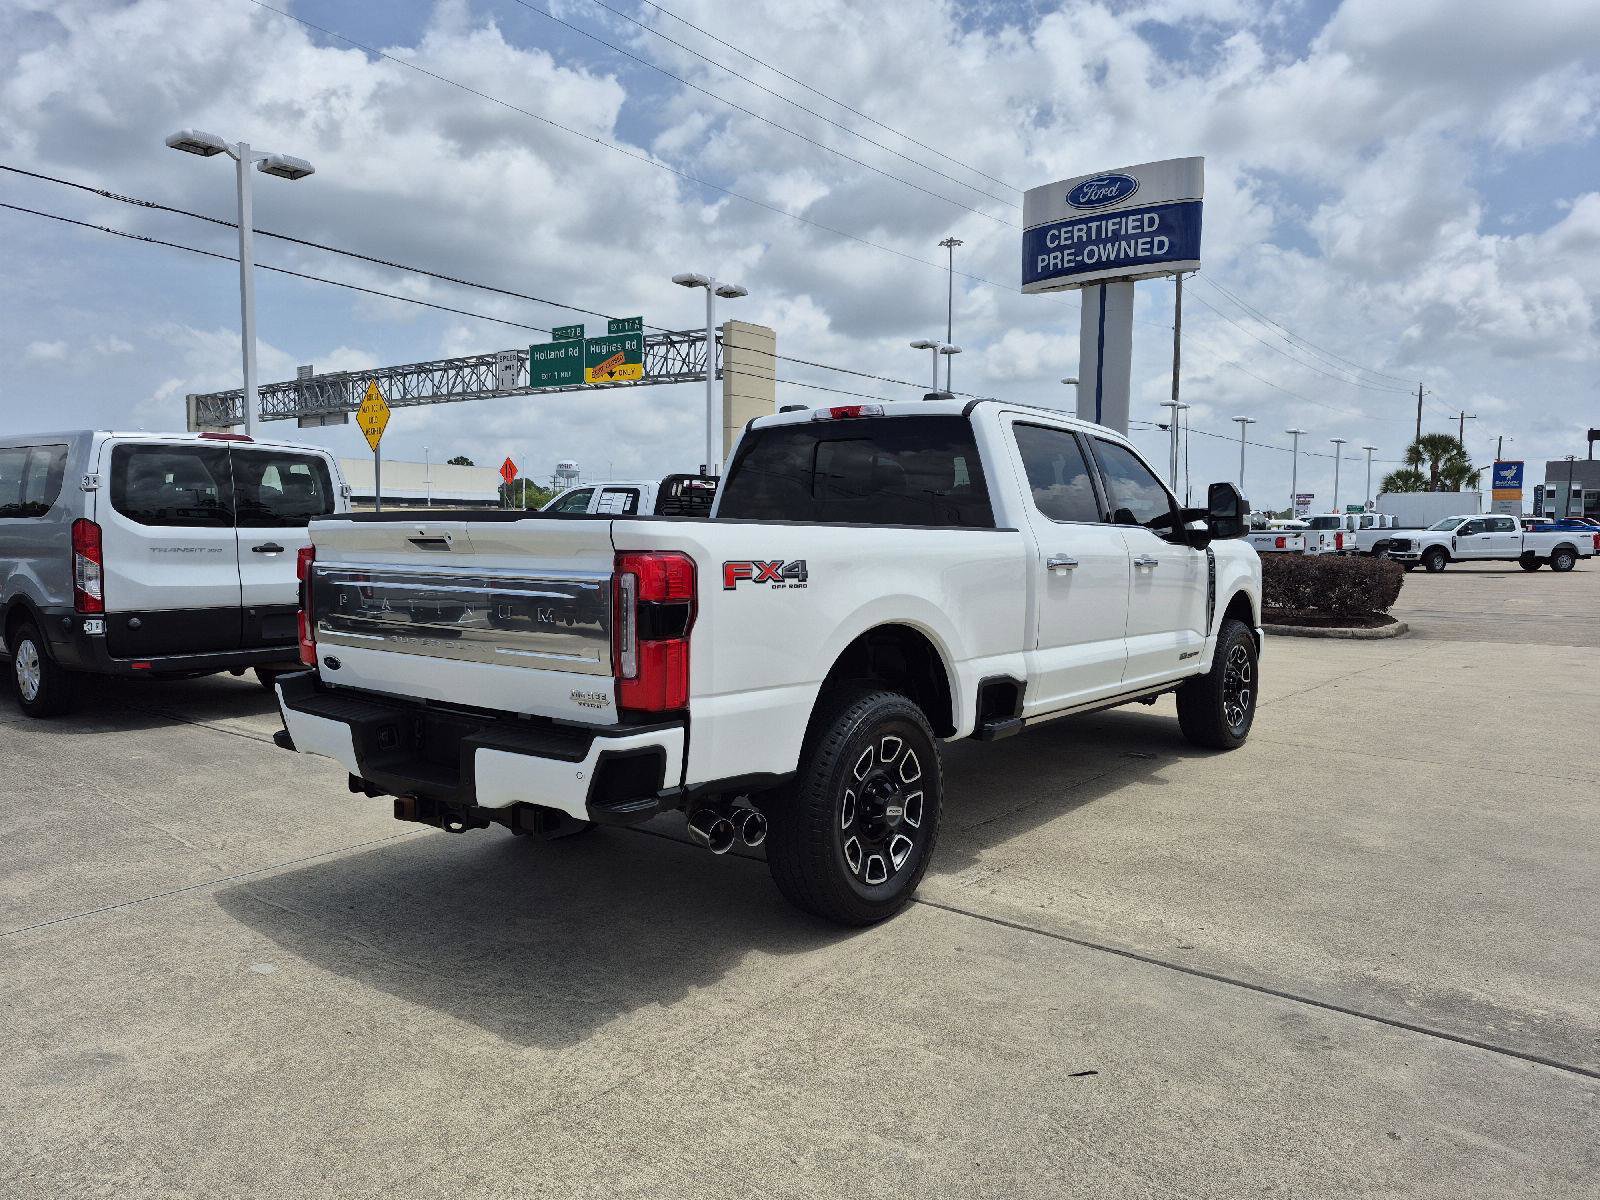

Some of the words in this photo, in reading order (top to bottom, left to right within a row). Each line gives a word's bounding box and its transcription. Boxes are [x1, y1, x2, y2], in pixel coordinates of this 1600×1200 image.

[1080, 180, 1120, 202] Ford
[1046, 213, 1160, 249] CERTIFIED
[1037, 235, 1170, 273] PRE-OWNED
[534, 349, 566, 361] Holland
[568, 346, 579, 357] Rd
[590, 342, 622, 355] Hughes
[625, 339, 637, 350] Rd
[500, 354, 517, 362] SPEED
[619, 367, 636, 377] ONLY
[723, 560, 808, 591] FX4
